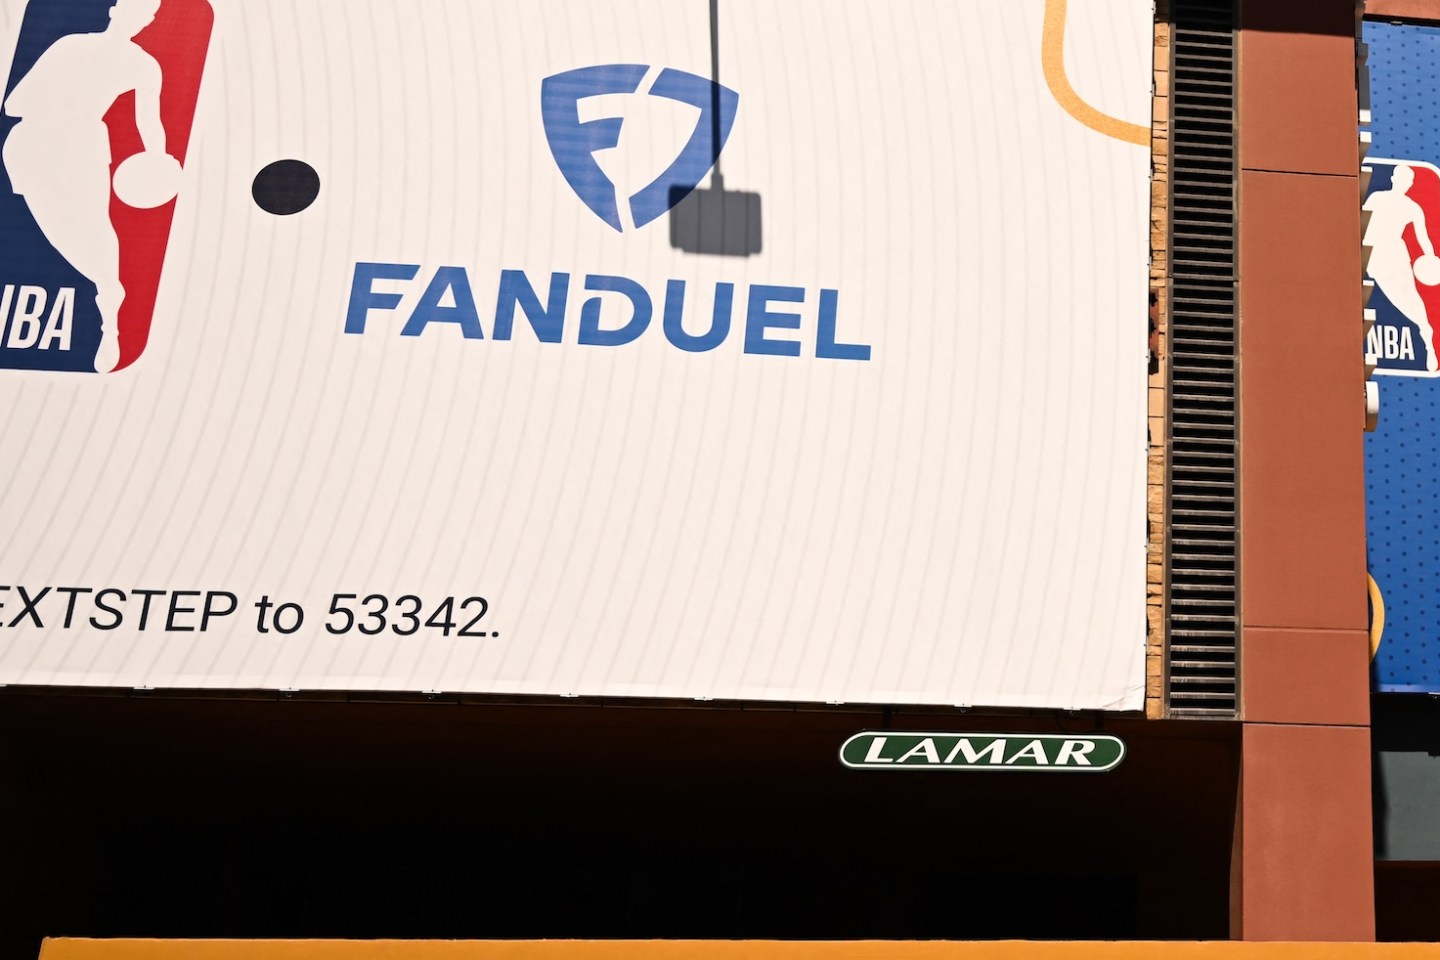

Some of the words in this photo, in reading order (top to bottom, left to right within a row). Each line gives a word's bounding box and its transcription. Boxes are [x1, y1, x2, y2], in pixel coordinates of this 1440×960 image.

[344, 261, 872, 361] FANDUEL
[1367, 324, 1415, 360] NBA
[254, 595, 304, 635] to
[325, 595, 500, 639] 53342.
[863, 736, 1096, 765] LAMAR
